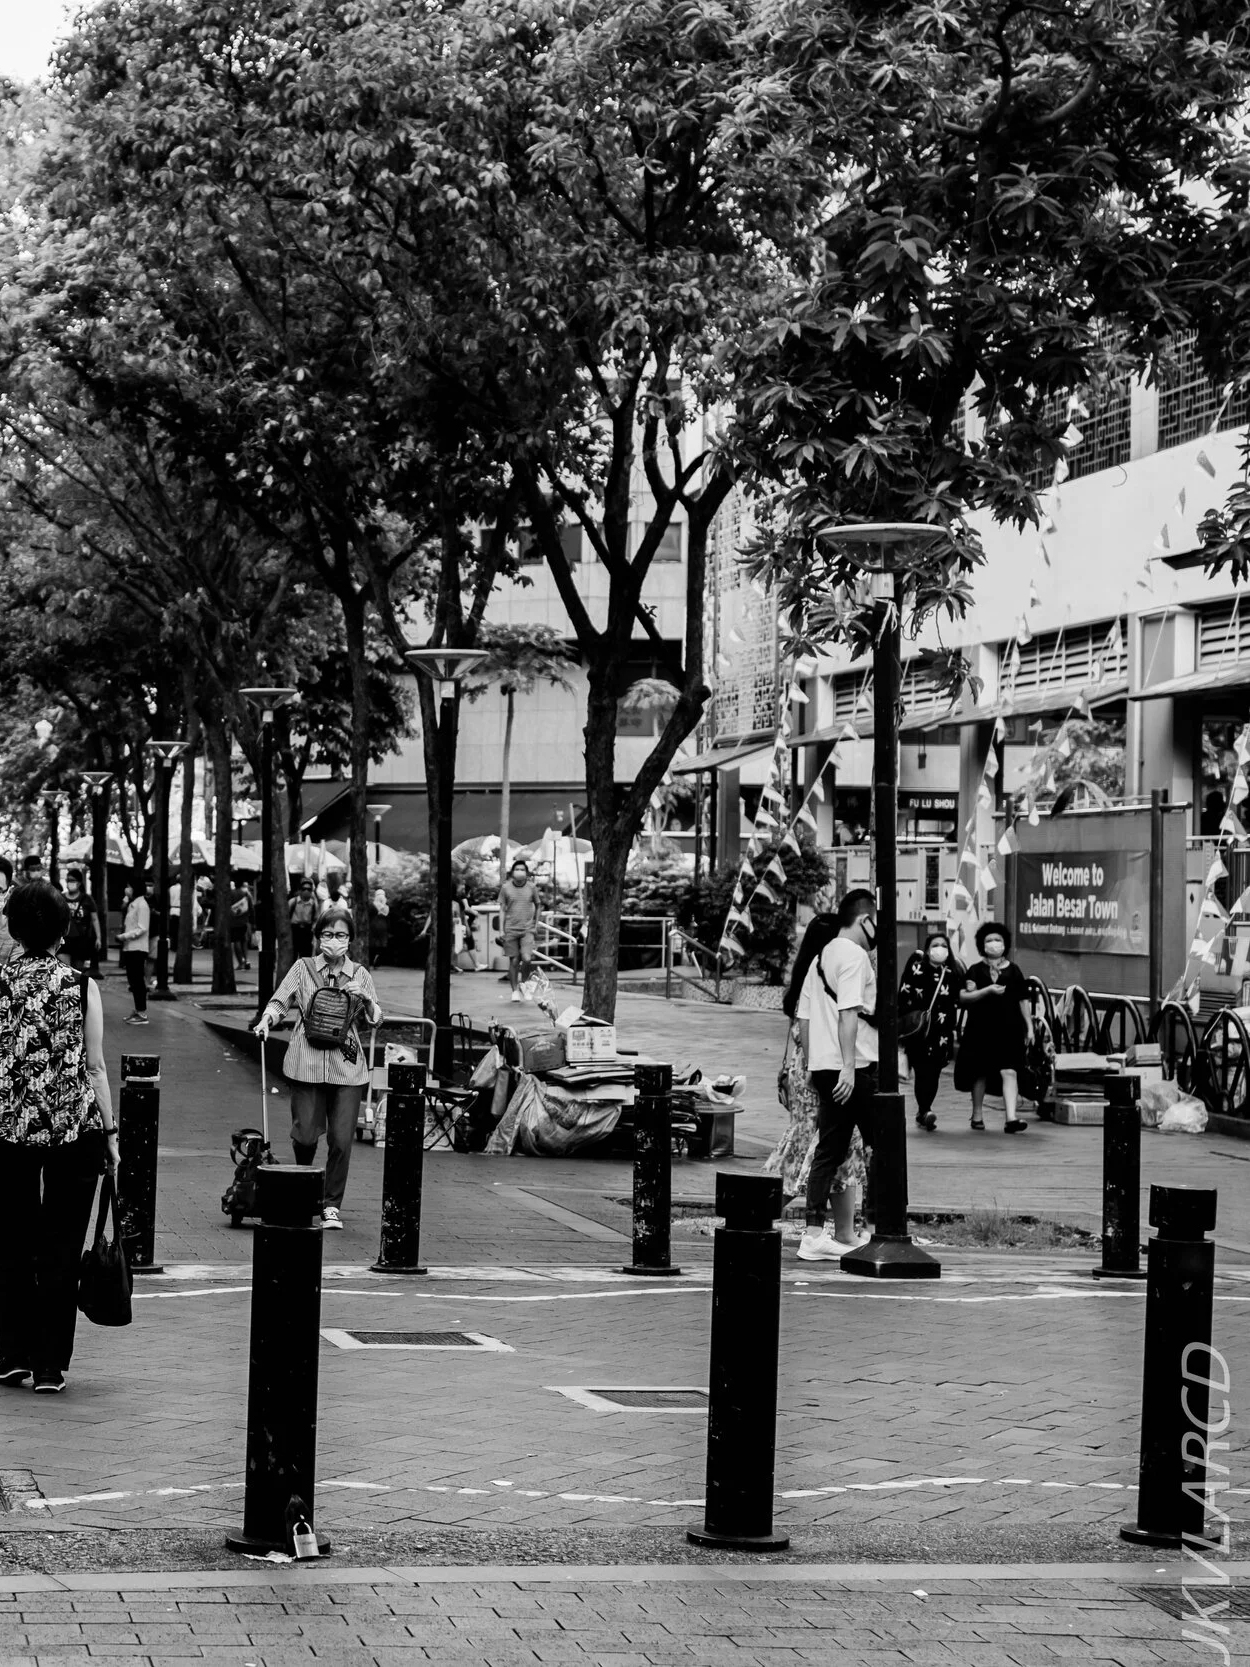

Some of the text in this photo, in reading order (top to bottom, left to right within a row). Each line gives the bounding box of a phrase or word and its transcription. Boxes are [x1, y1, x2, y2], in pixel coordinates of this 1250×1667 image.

[909, 798, 955, 810] FU LU SHOU
[1042, 862, 1104, 887] Welcome to
[1026, 892, 1119, 920] Jalan Besar Town
